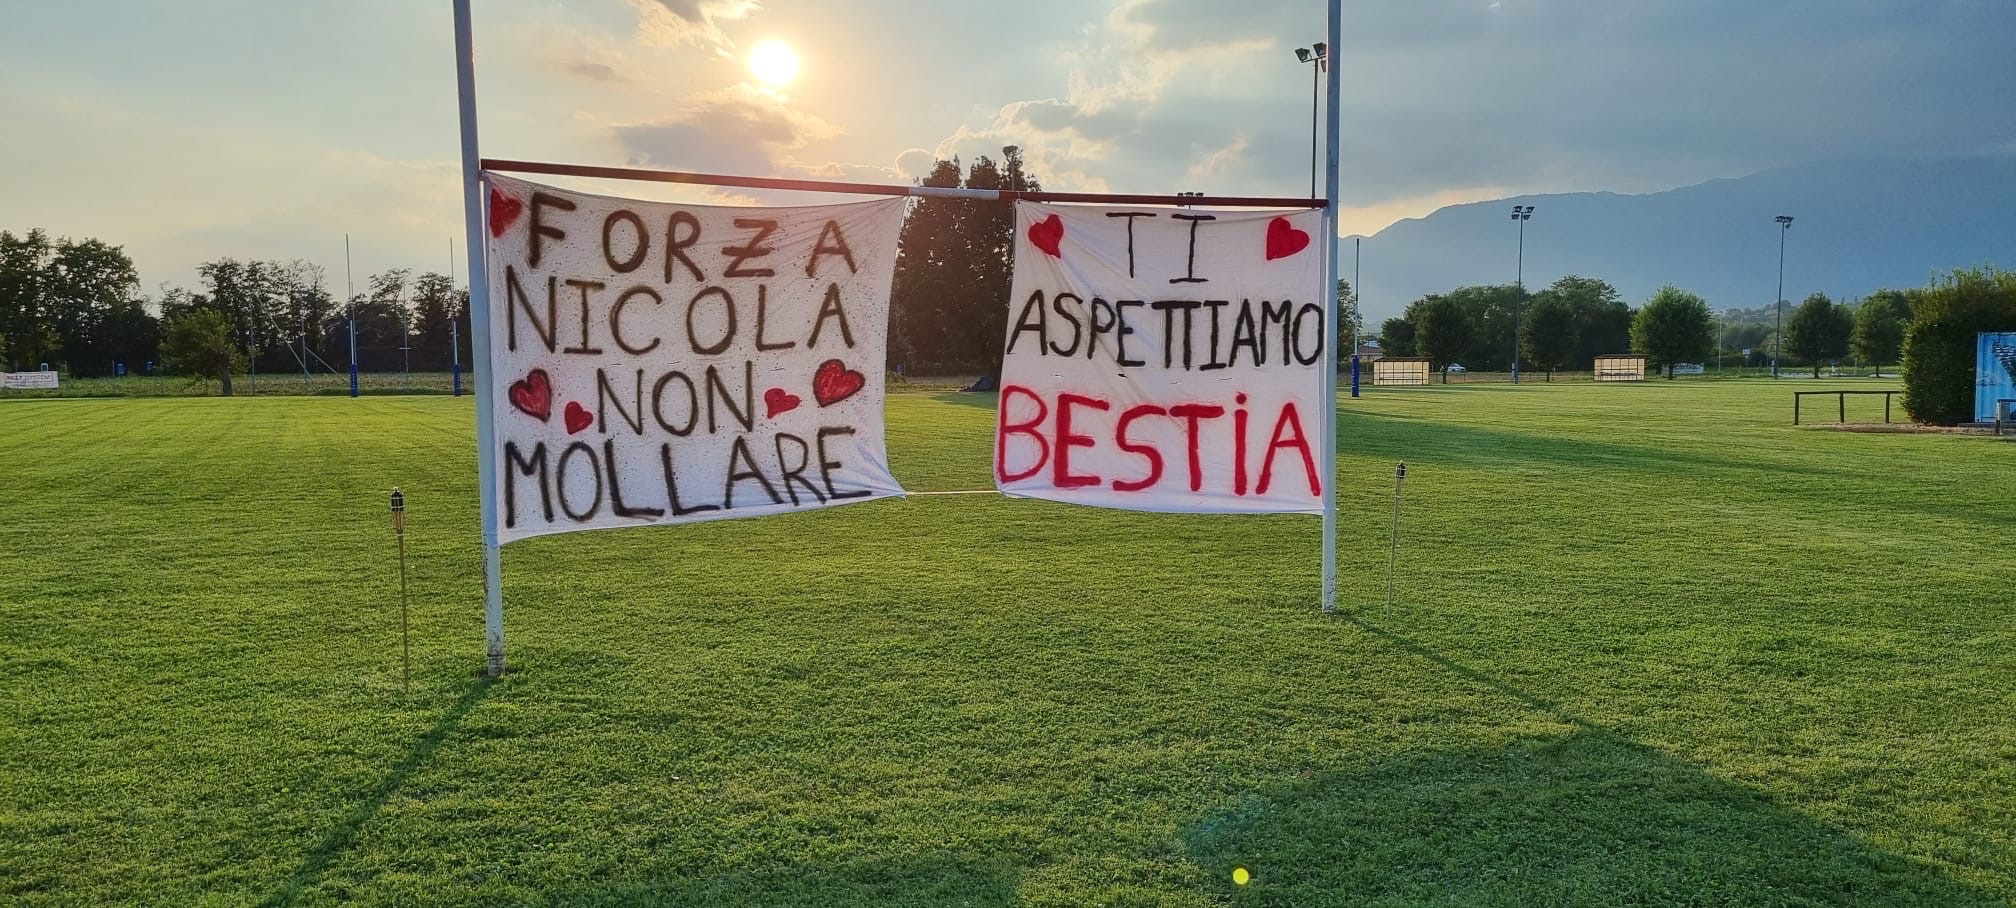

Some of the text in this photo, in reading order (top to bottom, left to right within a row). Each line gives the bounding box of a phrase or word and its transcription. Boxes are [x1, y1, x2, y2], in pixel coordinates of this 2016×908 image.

[529, 191, 858, 284] FORZA
[1106, 212, 1216, 284] TI
[506, 265, 857, 355] NICOLA
[1006, 289, 1325, 371] ASPETTIAMO
[598, 360, 755, 437] NON
[506, 426, 872, 529] MOLLARE
